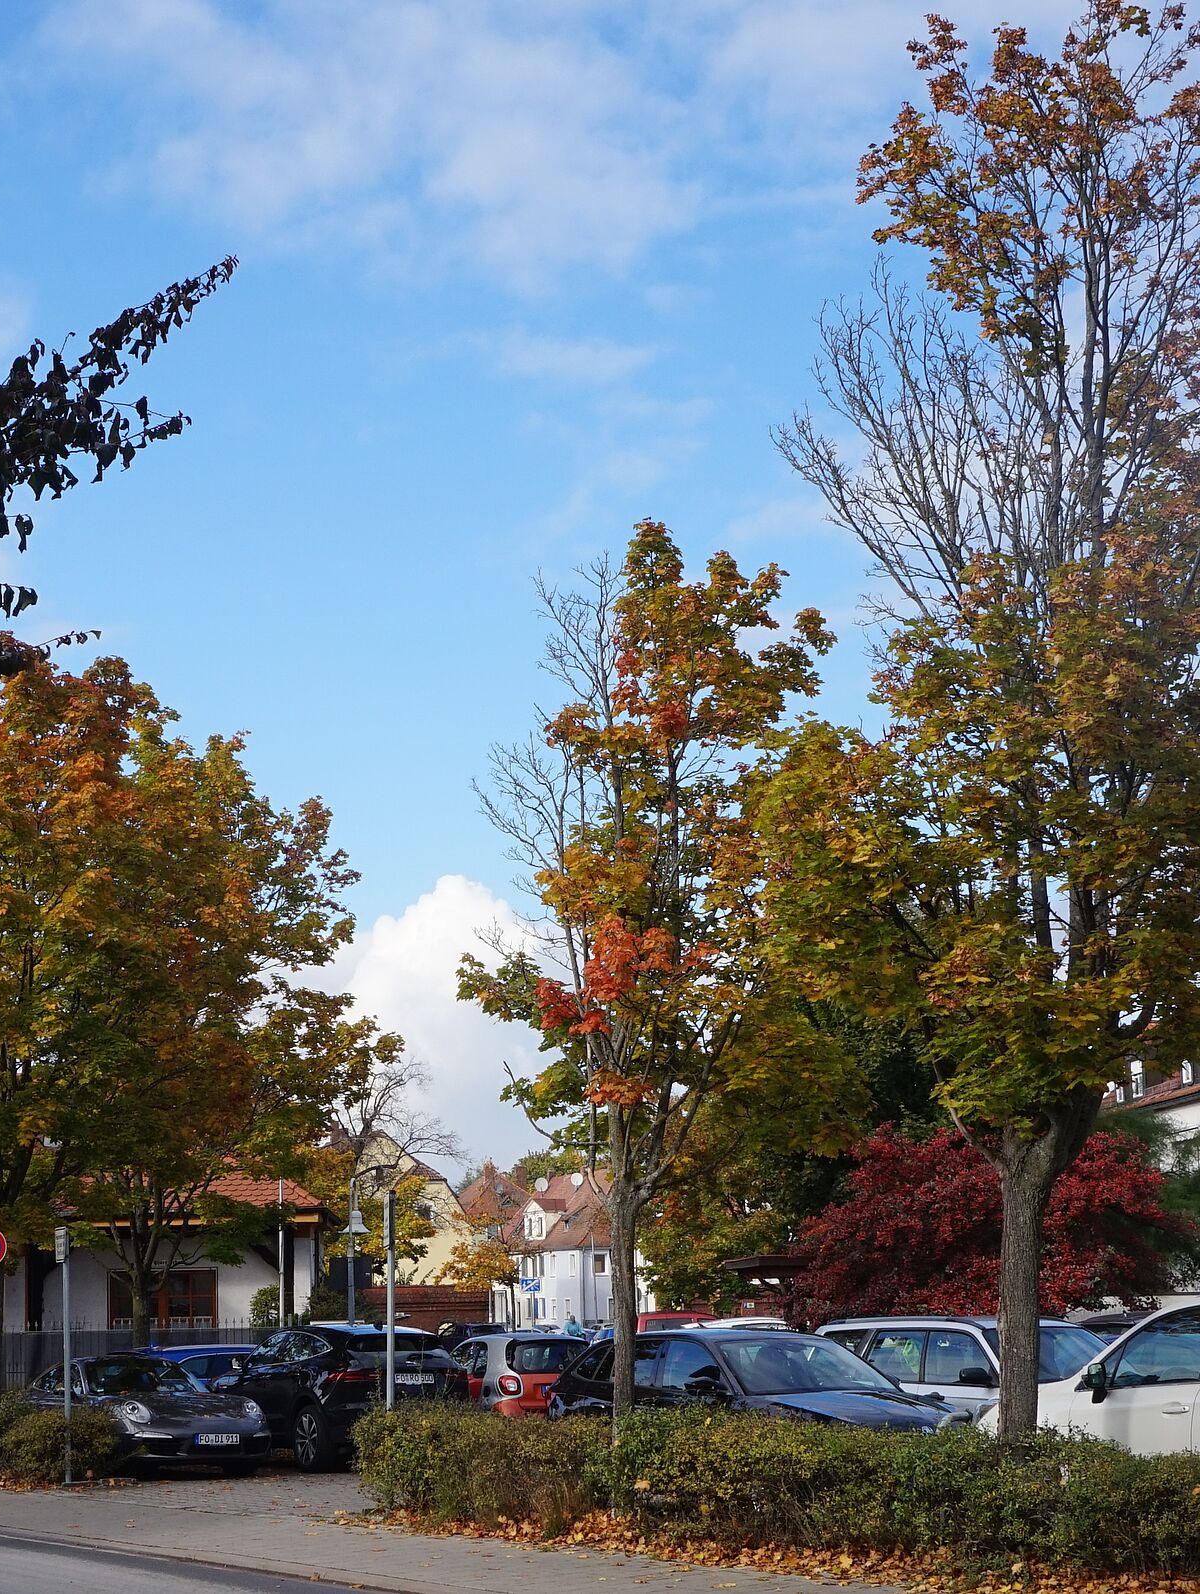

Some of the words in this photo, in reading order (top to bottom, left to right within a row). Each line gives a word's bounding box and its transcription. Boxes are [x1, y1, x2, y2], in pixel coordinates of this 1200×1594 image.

[199, 1434, 210, 1444] FO
[214, 1434, 224, 1444] DI
[225, 1434, 239, 1444] 911
